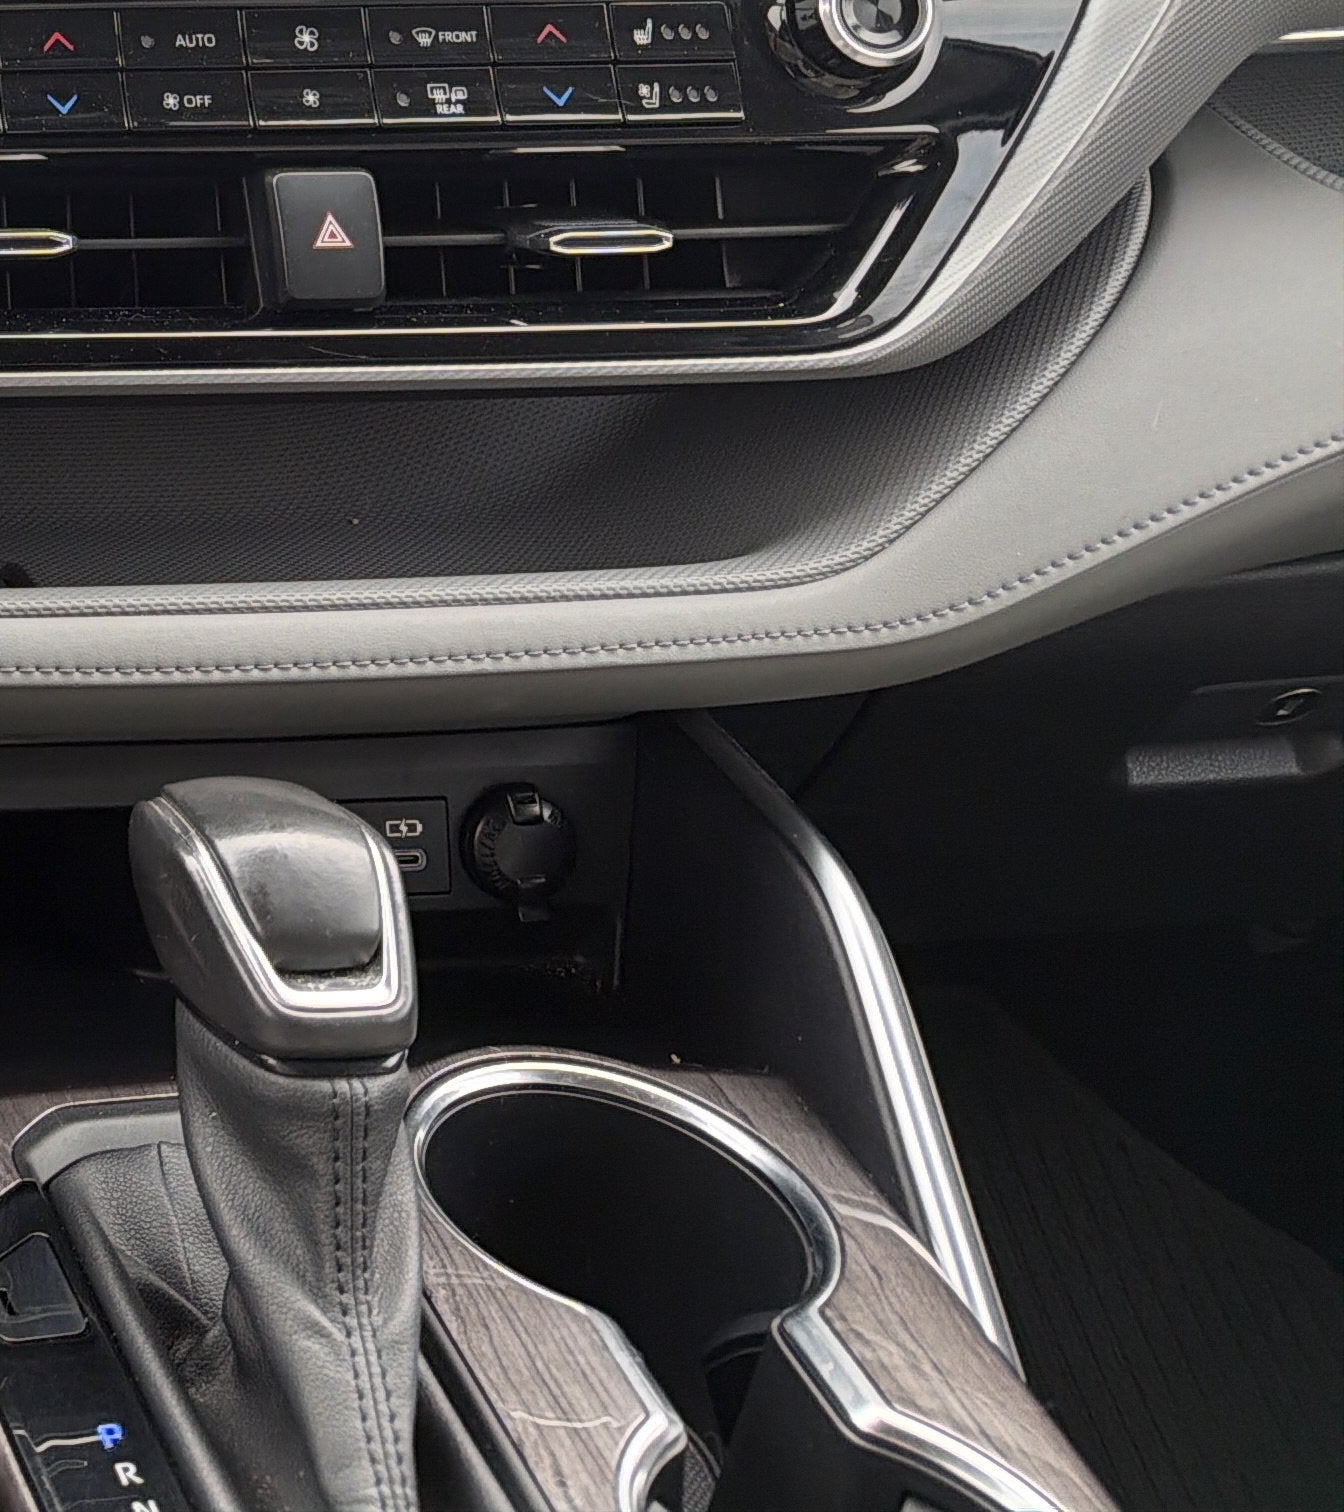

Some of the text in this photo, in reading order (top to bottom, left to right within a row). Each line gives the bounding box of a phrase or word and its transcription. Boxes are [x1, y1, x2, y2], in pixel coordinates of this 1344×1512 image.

[175, 33, 216, 49] AUTO
[438, 29, 478, 44] FRONT
[183, 94, 212, 109] OFF
[436, 103, 465, 115] REAR
[113, 1461, 144, 1486] R
